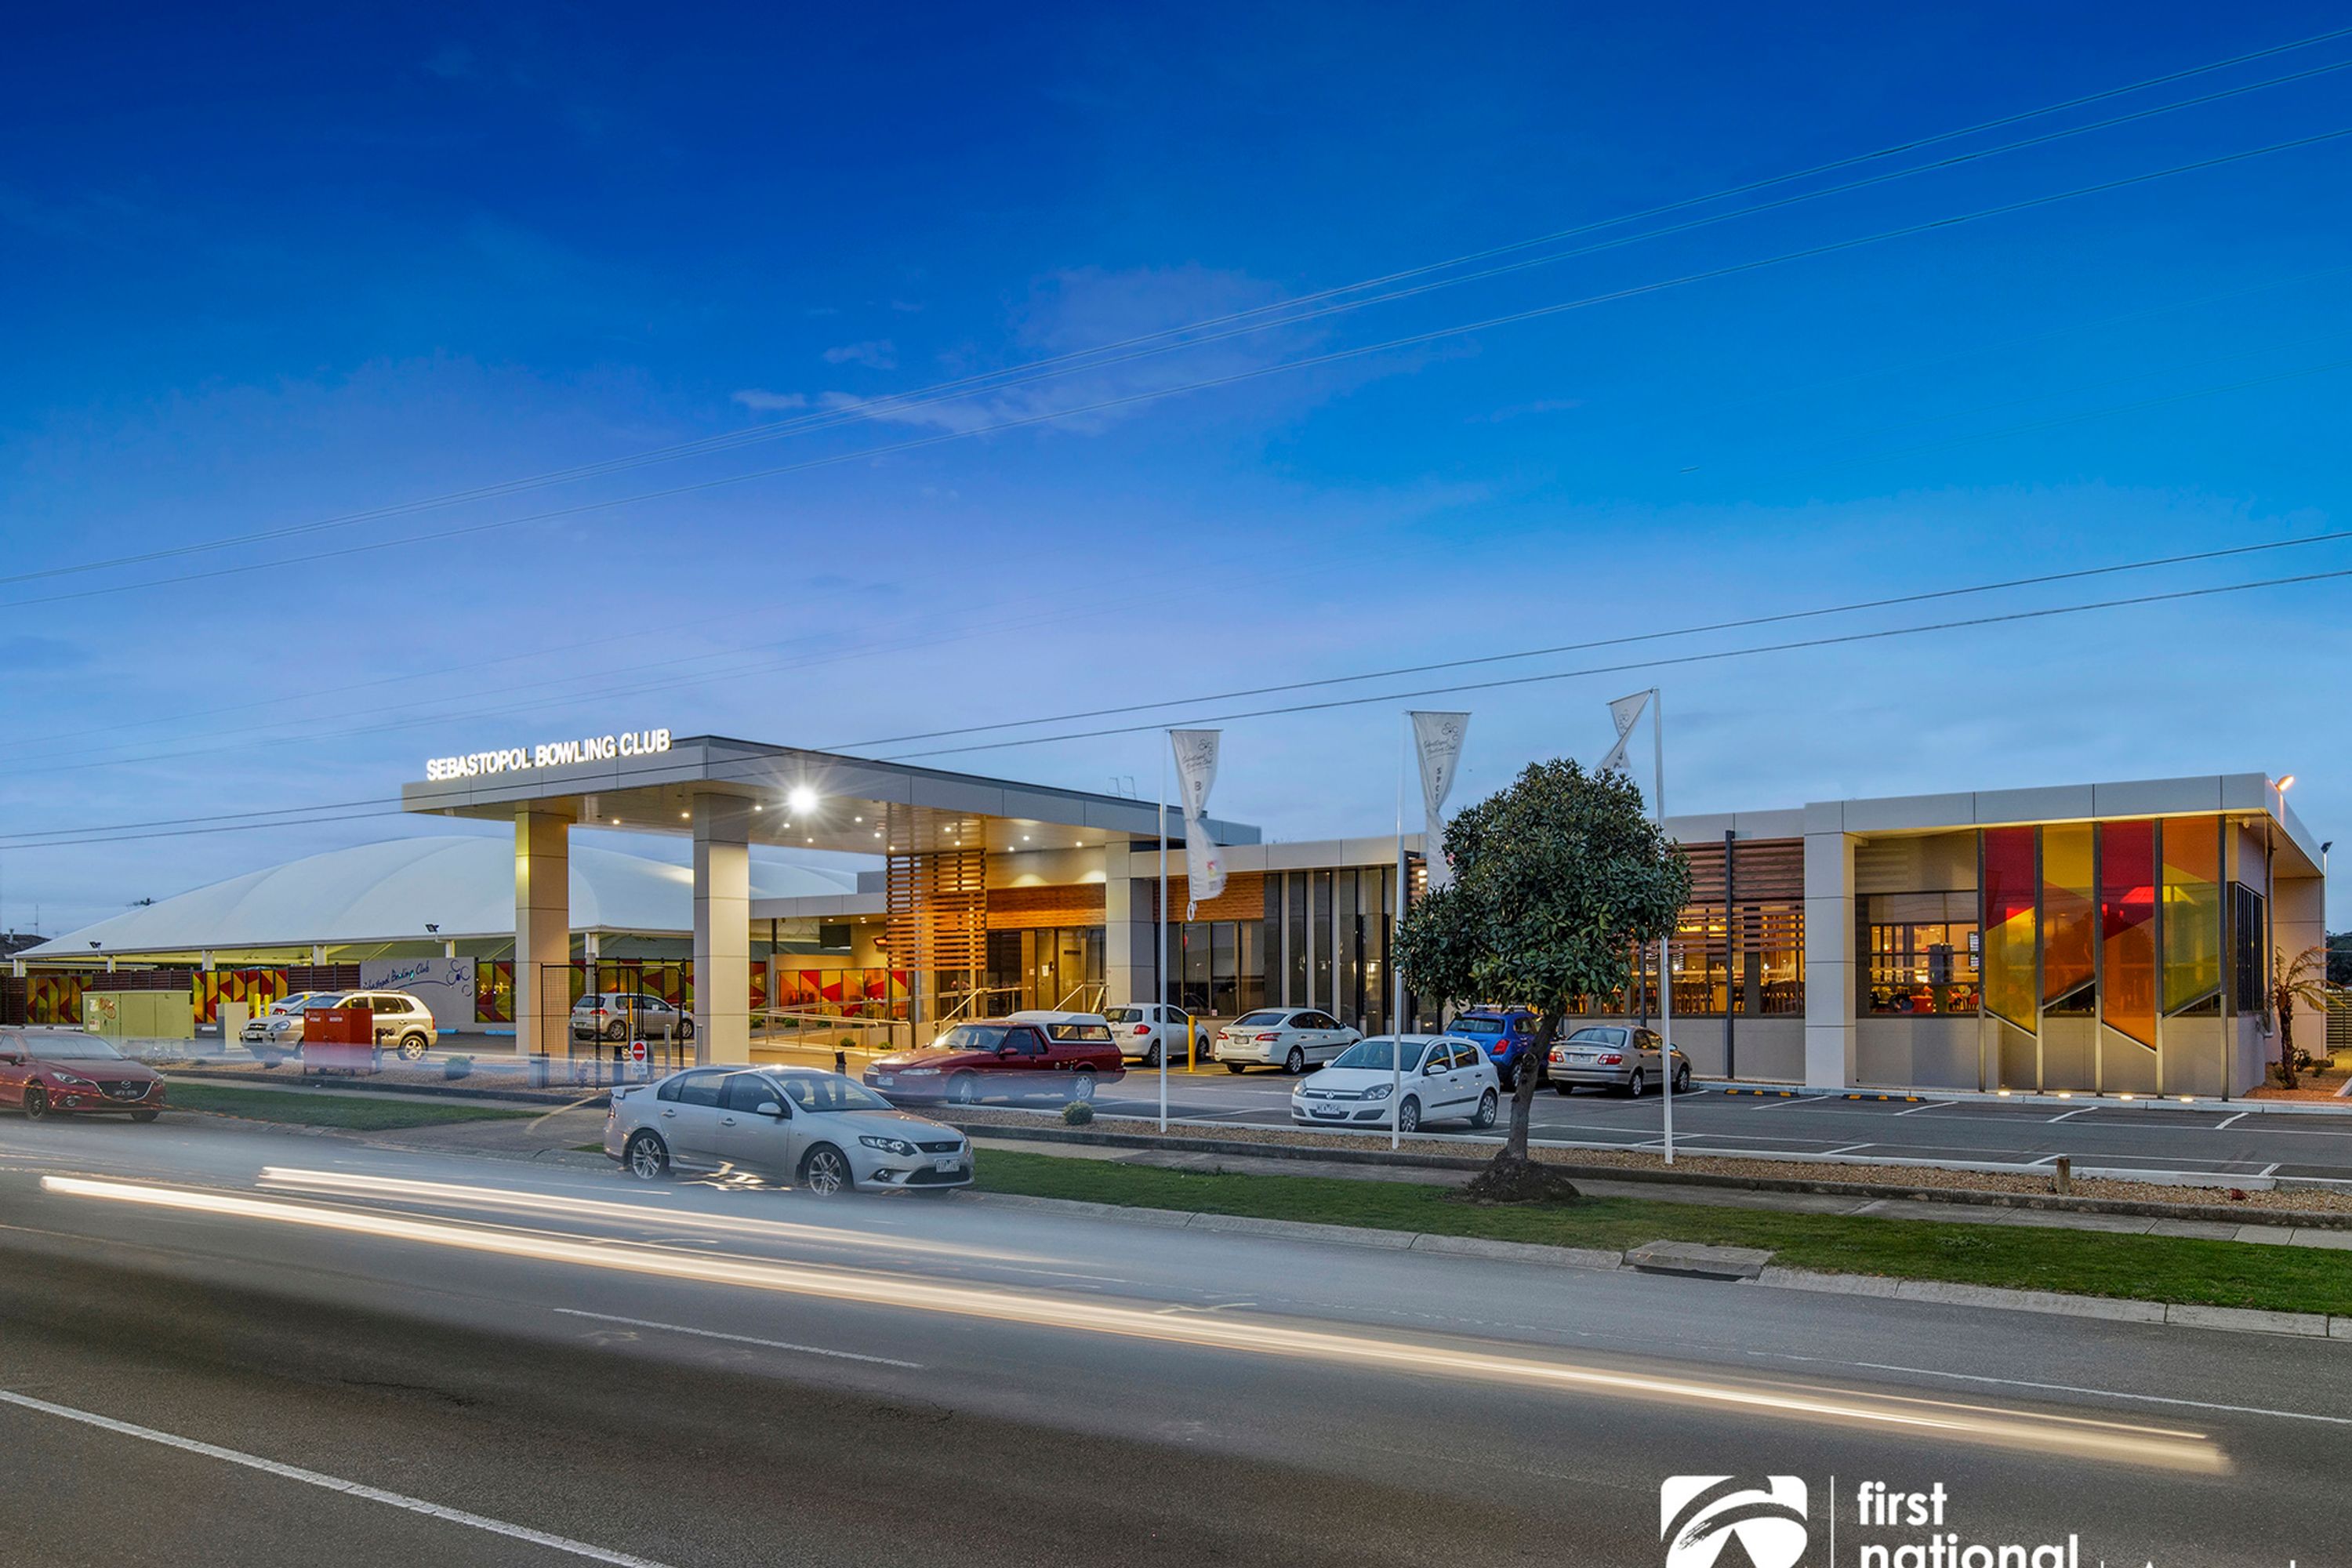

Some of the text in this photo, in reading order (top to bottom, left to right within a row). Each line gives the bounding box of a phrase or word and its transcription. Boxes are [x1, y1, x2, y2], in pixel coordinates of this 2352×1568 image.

[426, 728, 672, 781] SEBASTOPOL BOWLING CLUB
